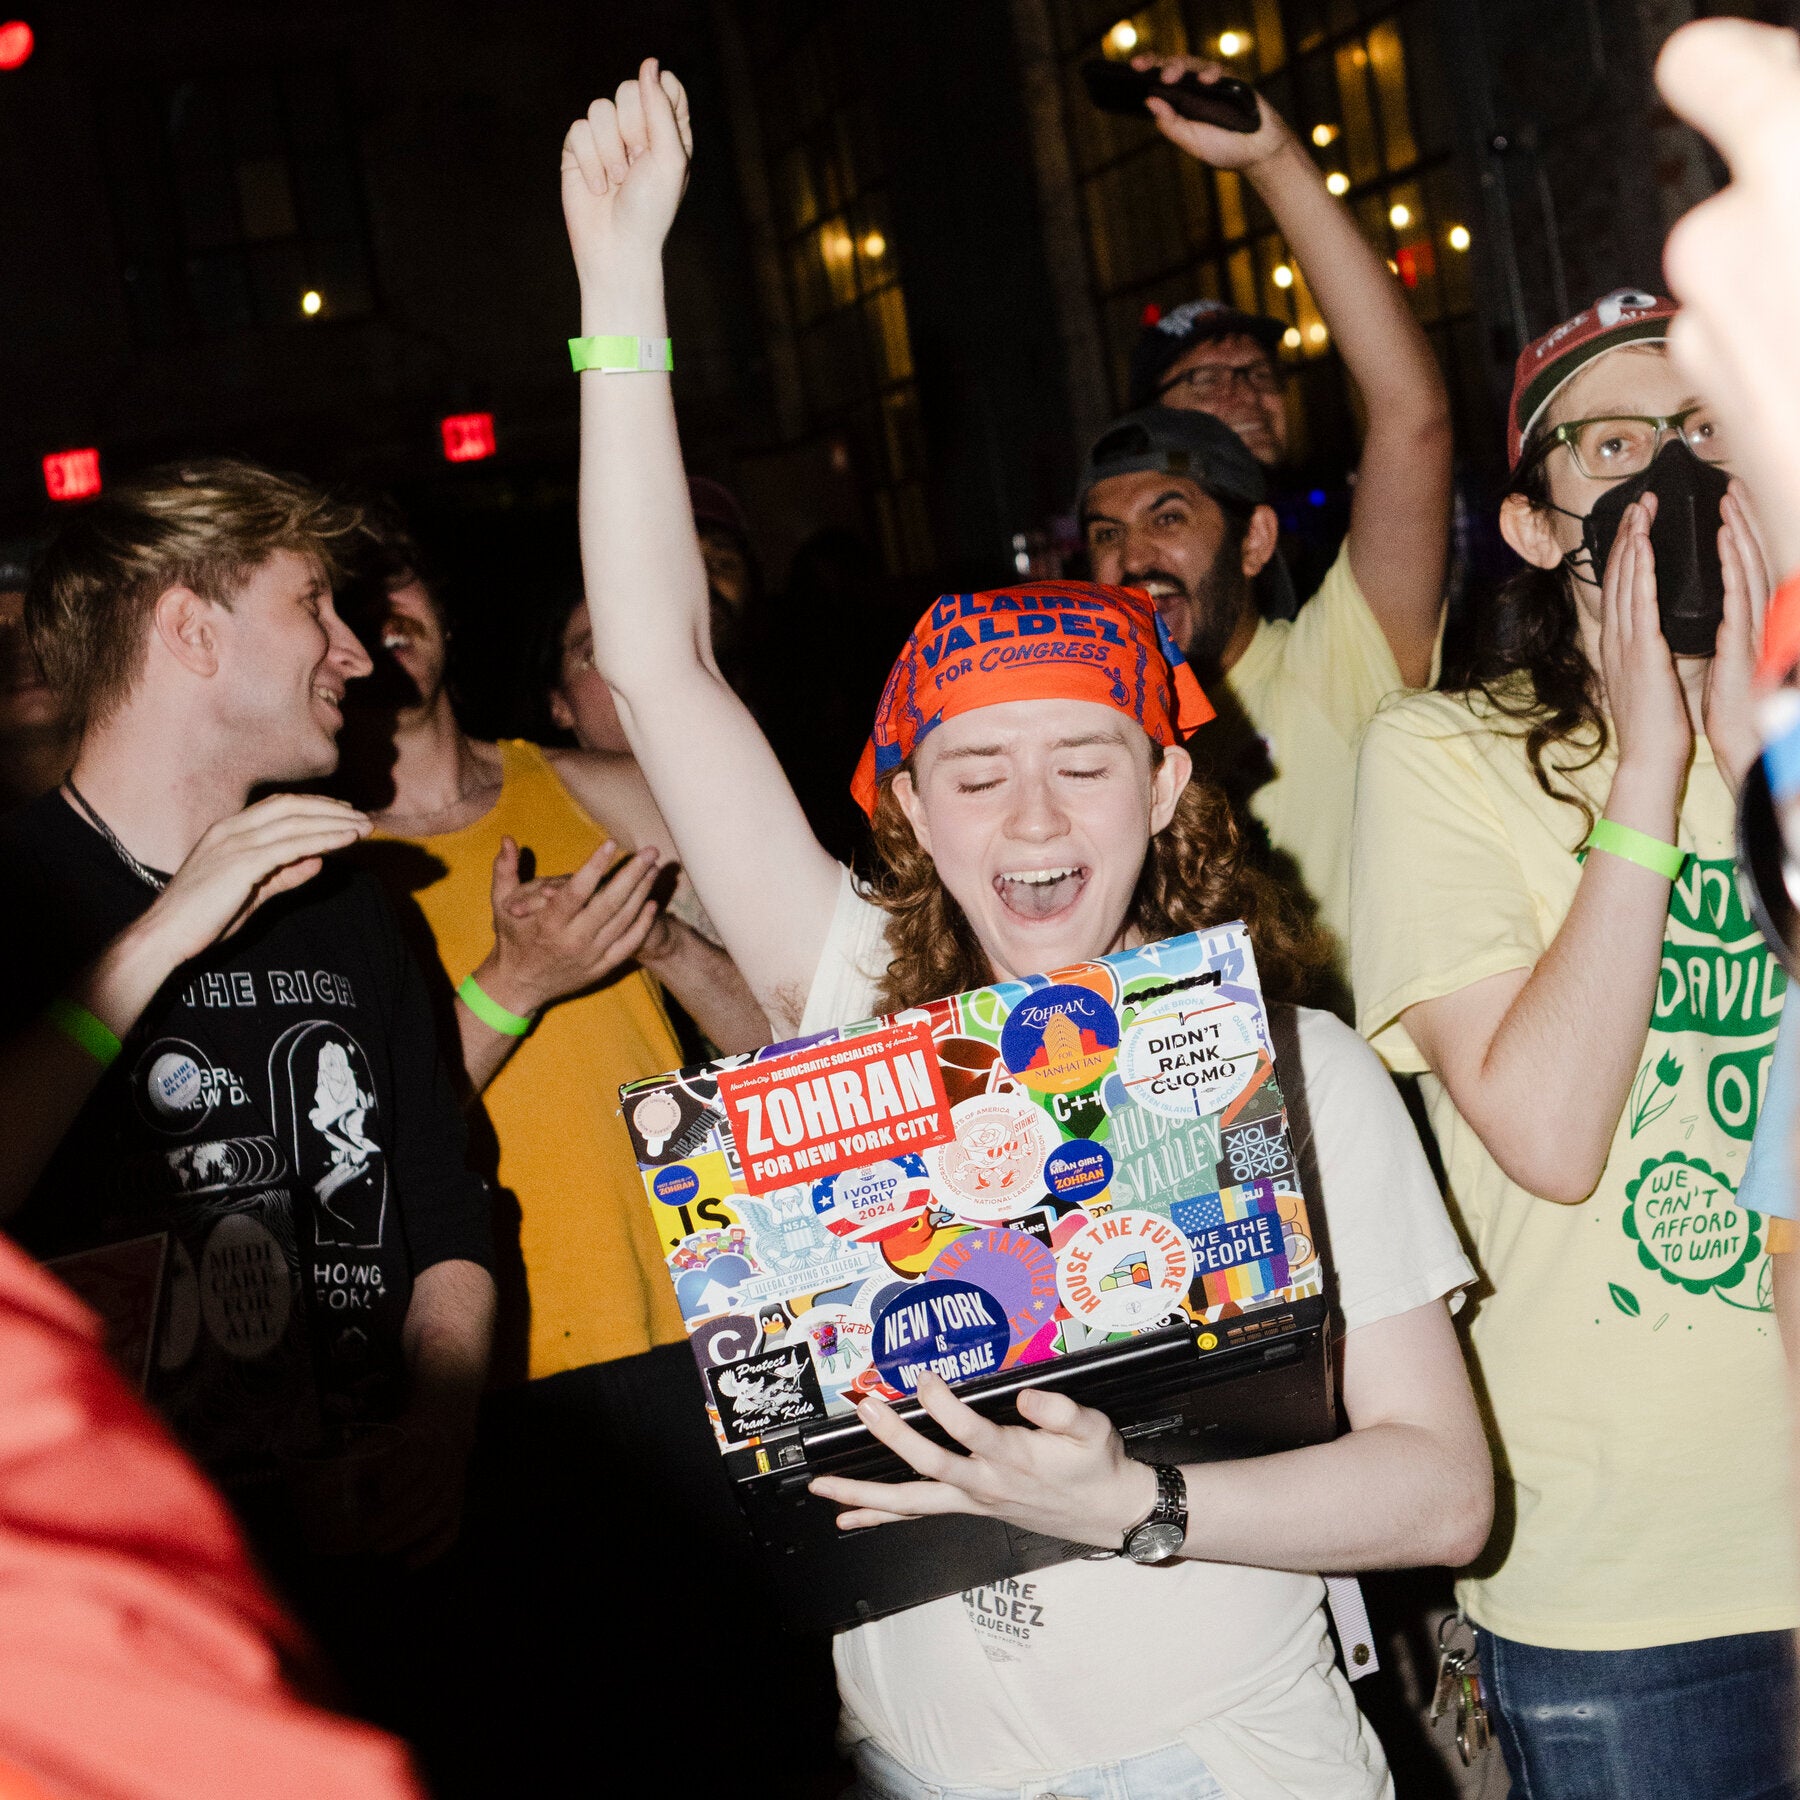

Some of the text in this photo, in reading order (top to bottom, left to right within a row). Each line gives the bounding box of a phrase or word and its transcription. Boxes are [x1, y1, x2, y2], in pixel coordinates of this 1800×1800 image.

[921, 613, 1127, 669] VALDEZ
[935, 642, 1110, 690] FOR CONGRESS
[268, 970, 357, 1007] RICH
[1021, 999, 1096, 1029] ZOHRAN
[1154, 998, 1205, 1016] THE BRONX
[1148, 1023, 1222, 1054] DIDN'T
[1233, 1015, 1250, 1045] QUEEN
[771, 1056, 831, 1082] DEMOCRATIC
[831, 1042, 885, 1066] SOCIALISTS
[885, 1041, 892, 1049] of
[892, 1034, 918, 1047] America
[1035, 1056, 1102, 1079] MANHATTAN
[1127, 1027, 1144, 1079] MANHATTAN
[1159, 1045, 1221, 1073] RANK
[163, 1060, 190, 1088] CLAIRE
[1151, 1063, 1236, 1095] CUOMO
[735, 1049, 936, 1156] ZOHRAN
[965, 1107, 1010, 1121] OF AMERICA
[1052, 1090, 1102, 1122] C++
[1135, 1085, 1193, 1113] STATEN ISLAND
[1014, 1112, 1037, 1132] STRIKE!
[752, 1157, 793, 1182] FOR
[794, 1142, 838, 1170] NEW
[839, 1126, 894, 1156] YORK
[895, 1113, 939, 1142] CITY
[1126, 1115, 1223, 1201] VALLEY
[938, 1155, 962, 1195] DEMOCRATIC
[975, 1135, 1047, 1205] NATIONAL LABOR COMMISSION
[1050, 1155, 1104, 1175] MEAN GIRLS
[1054, 1168, 1105, 1190] ZOHRAN
[658, 1180, 695, 1196] ZOHRAN
[843, 1178, 898, 1200] I VOTED
[1236, 1187, 1264, 1204] ACLU
[1652, 1170, 1688, 1195] WE
[852, 1190, 894, 1209] EARLY
[859, 1202, 896, 1220] 2024
[1646, 1187, 1719, 1219] CAN'T
[782, 1219, 808, 1232] NSA
[1190, 1218, 1269, 1249] WE THE
[1651, 1211, 1738, 1239] AFFORD
[988, 1231, 1056, 1297] FAMILIES
[1194, 1232, 1274, 1273] PEOPLE
[1661, 1236, 1740, 1262] TO WAIT
[755, 1258, 863, 1294] ILLEGAL SPYING IS ILLEGAL
[1066, 1217, 1187, 1314] HOUSE THE FUTURE
[835, 1314, 847, 1324] I
[884, 1301, 930, 1356] NEW
[929, 1292, 997, 1333] YORK
[935, 1334, 948, 1352] IS
[735, 1354, 786, 1378] Protect
[930, 1353, 961, 1381] FOR
[959, 1341, 996, 1374] SALE
[732, 1415, 771, 1434] Trans
[780, 1401, 815, 1420] Kids
[961, 1590, 1045, 1627] ALDEZ
[977, 1614, 1031, 1640] QUEENS
